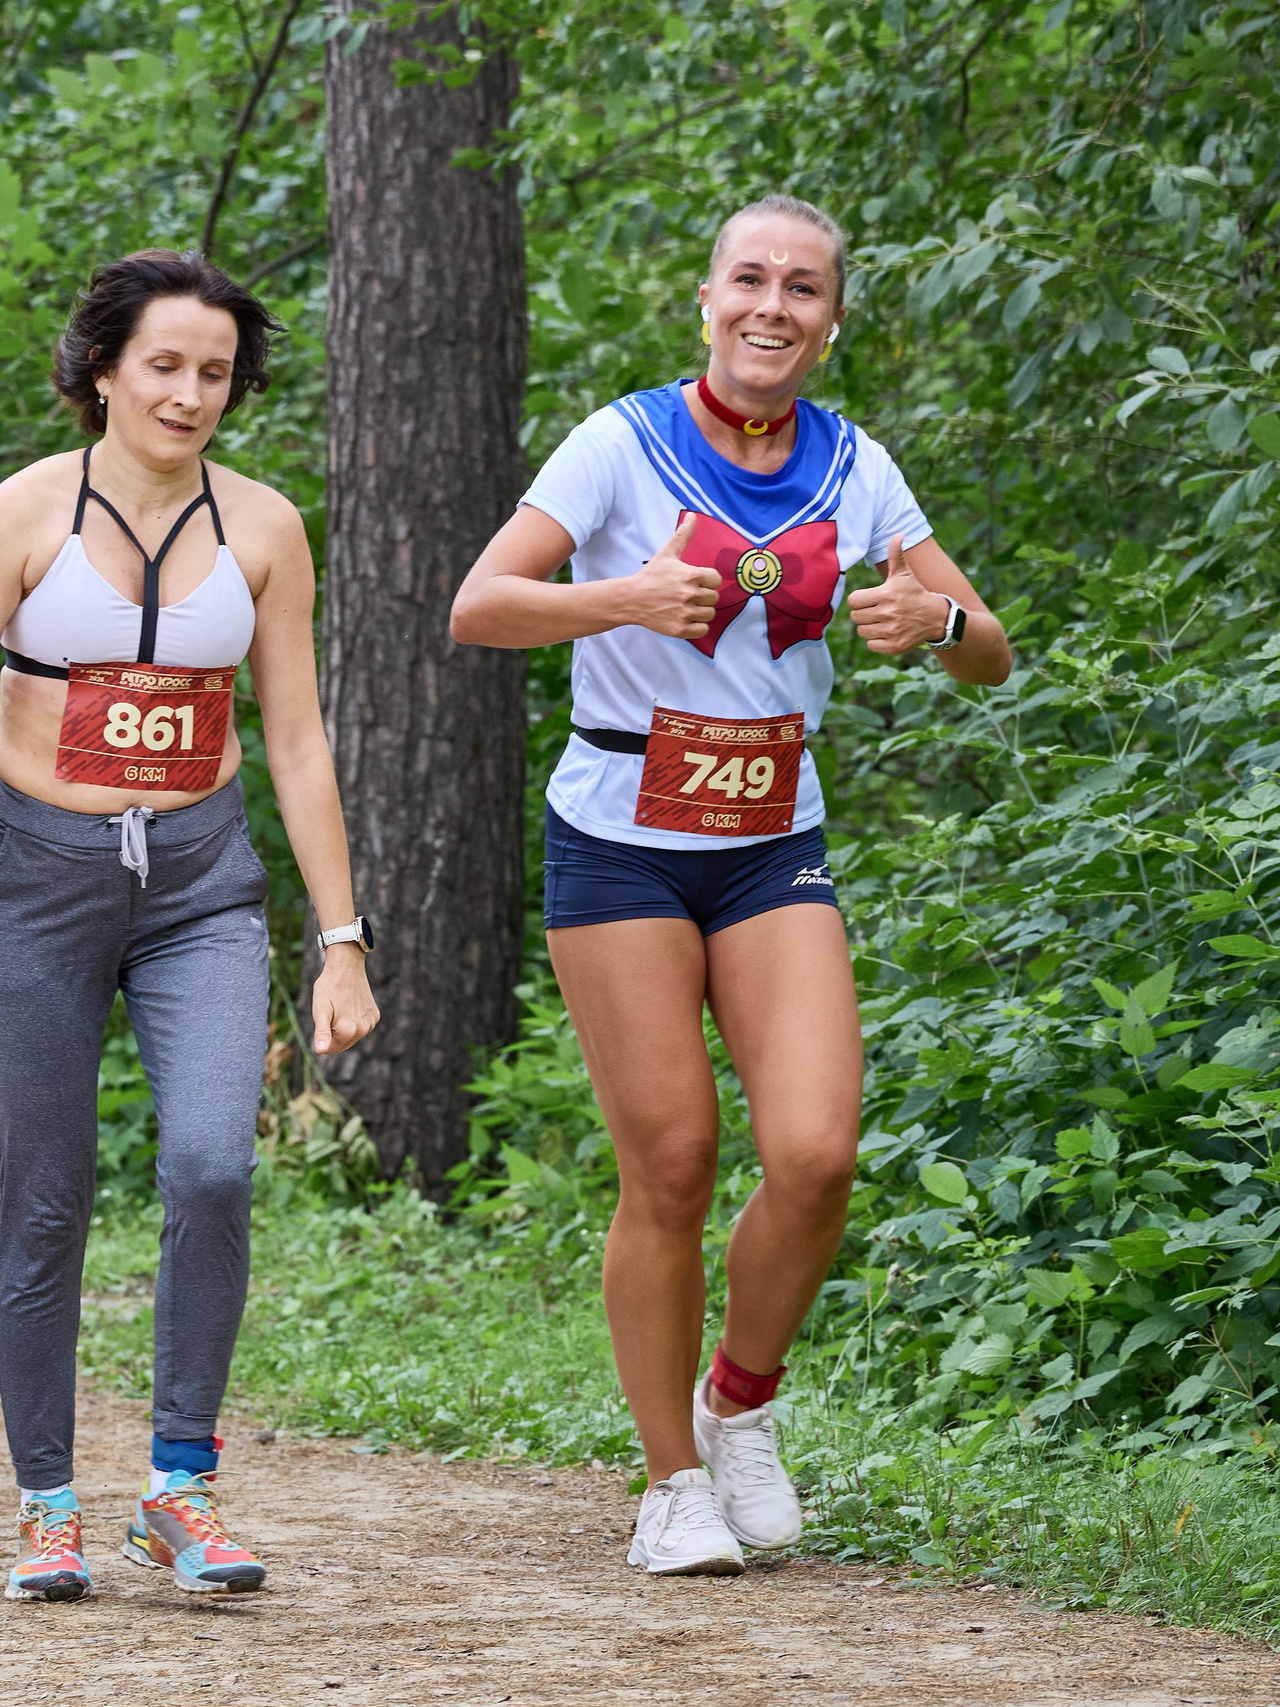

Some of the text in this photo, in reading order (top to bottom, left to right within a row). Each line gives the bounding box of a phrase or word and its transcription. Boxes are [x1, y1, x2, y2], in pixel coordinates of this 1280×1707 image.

[121, 672, 156, 686] РЕТРО
[157, 676, 193, 687] КРОСС
[103, 702, 194, 751] 861
[702, 725, 736, 738] РЕТРО
[737, 728, 770, 739] КРОСС
[124, 765, 167, 782] 6 КМ
[679, 751, 775, 799] 749
[701, 812, 742, 828] 6 КМ
